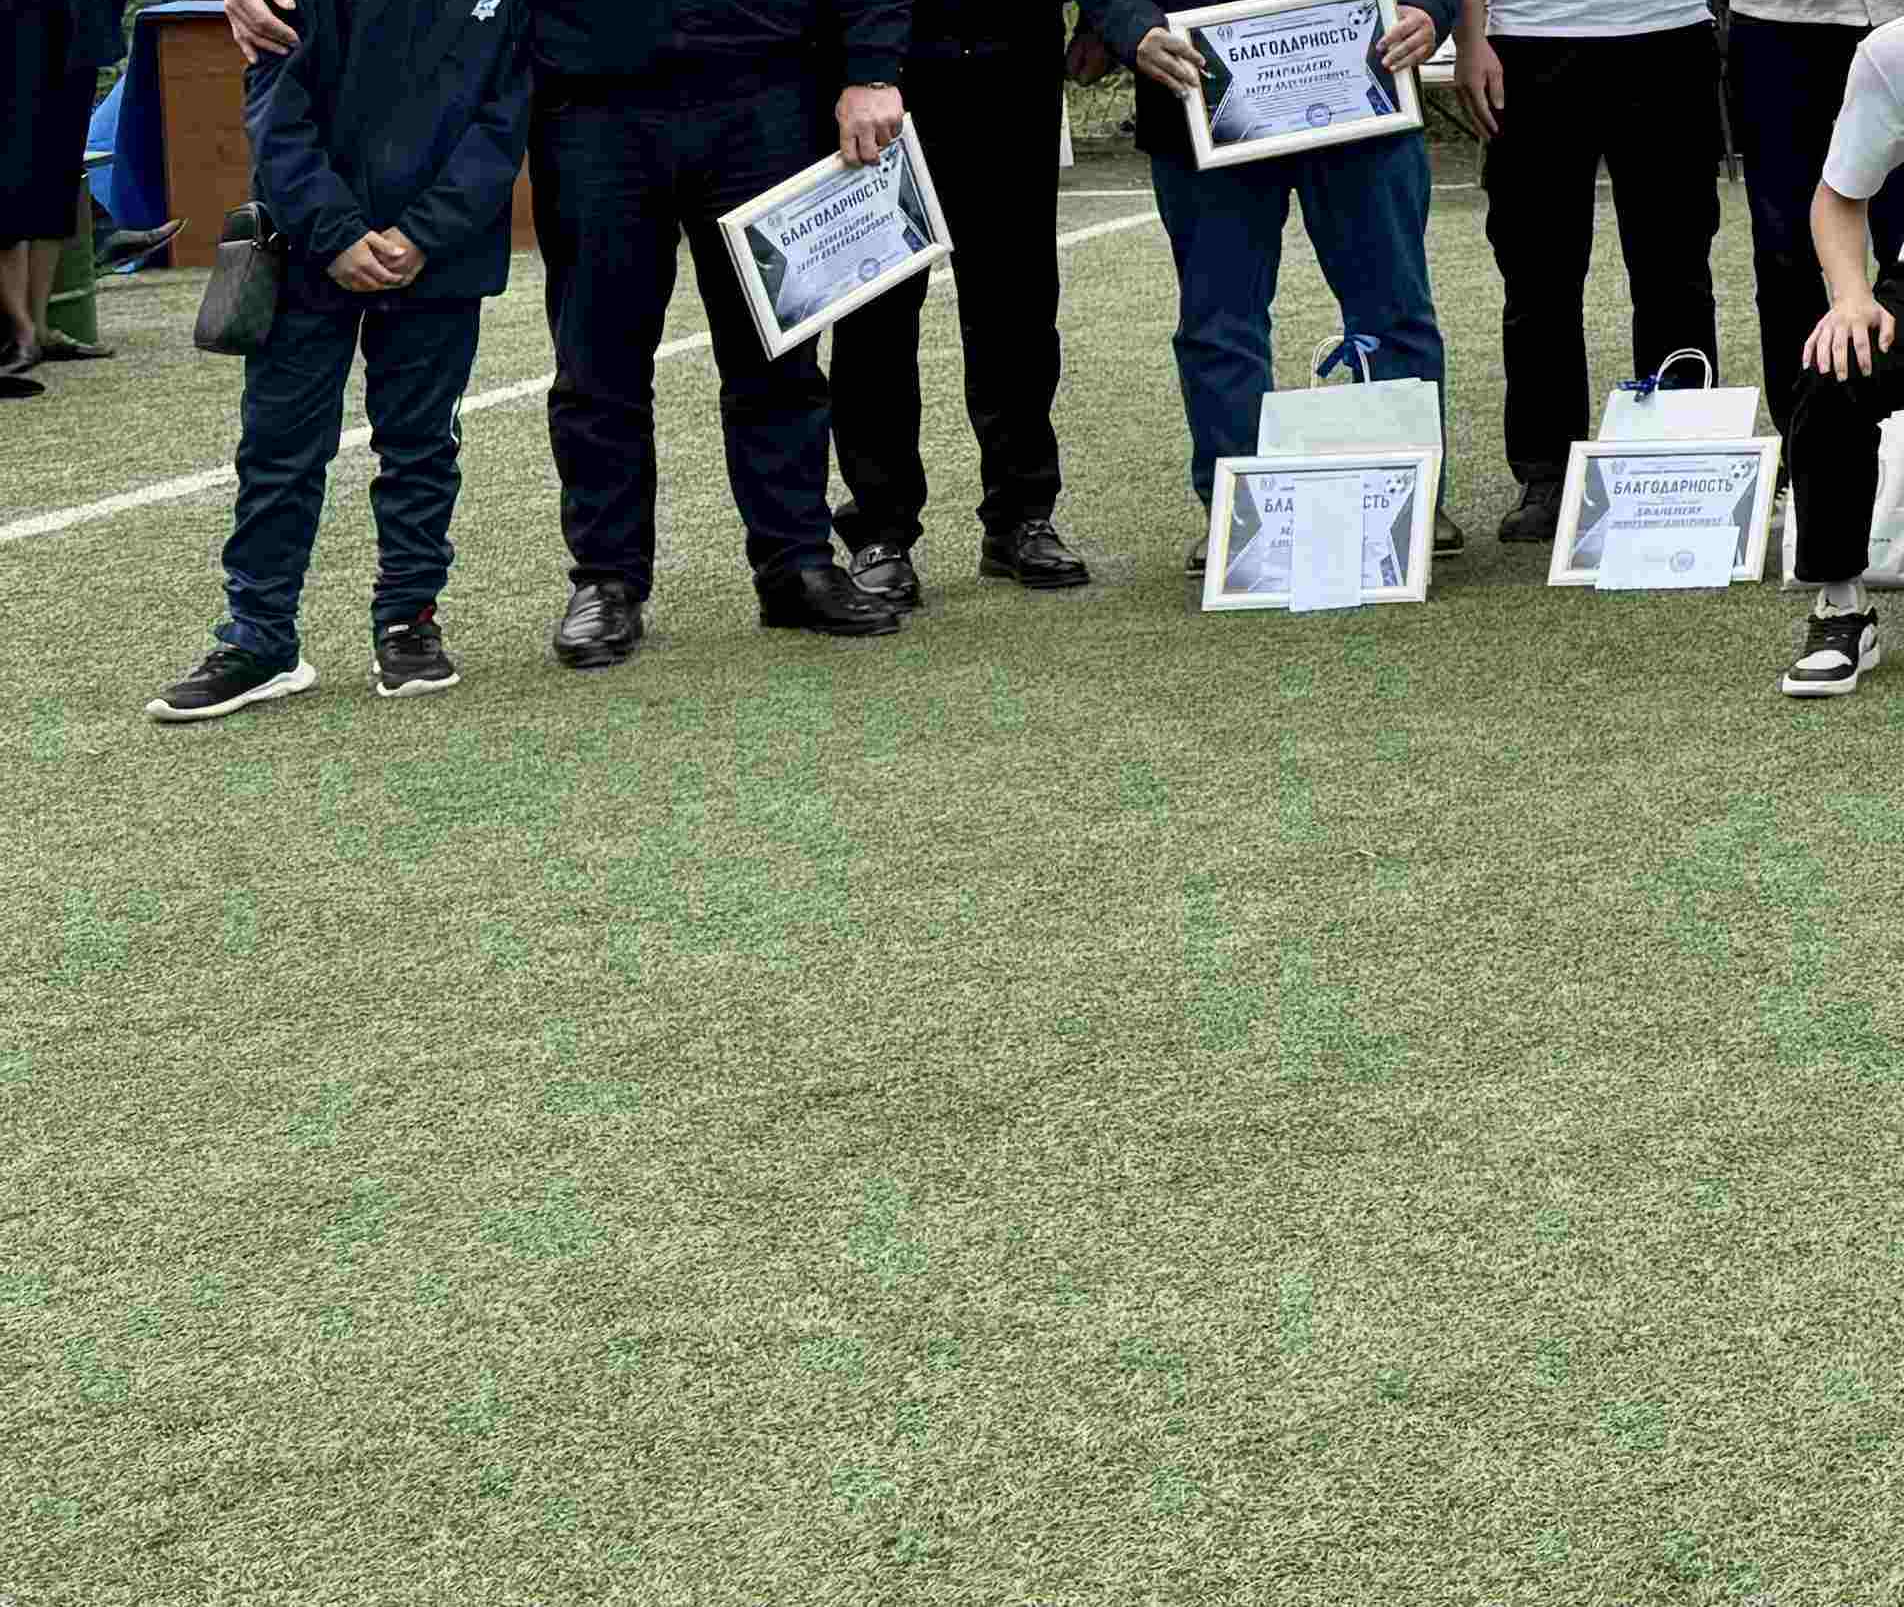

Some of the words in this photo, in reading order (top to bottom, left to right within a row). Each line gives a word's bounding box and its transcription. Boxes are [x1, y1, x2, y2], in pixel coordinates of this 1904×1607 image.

[1229, 27, 1358, 63] БЛАГОДАРНОСТЬ
[780, 177, 889, 247] БЛАГОДАРНОСТЬ
[1613, 477, 1734, 495] БЛАГОДАРНОСТЬ
